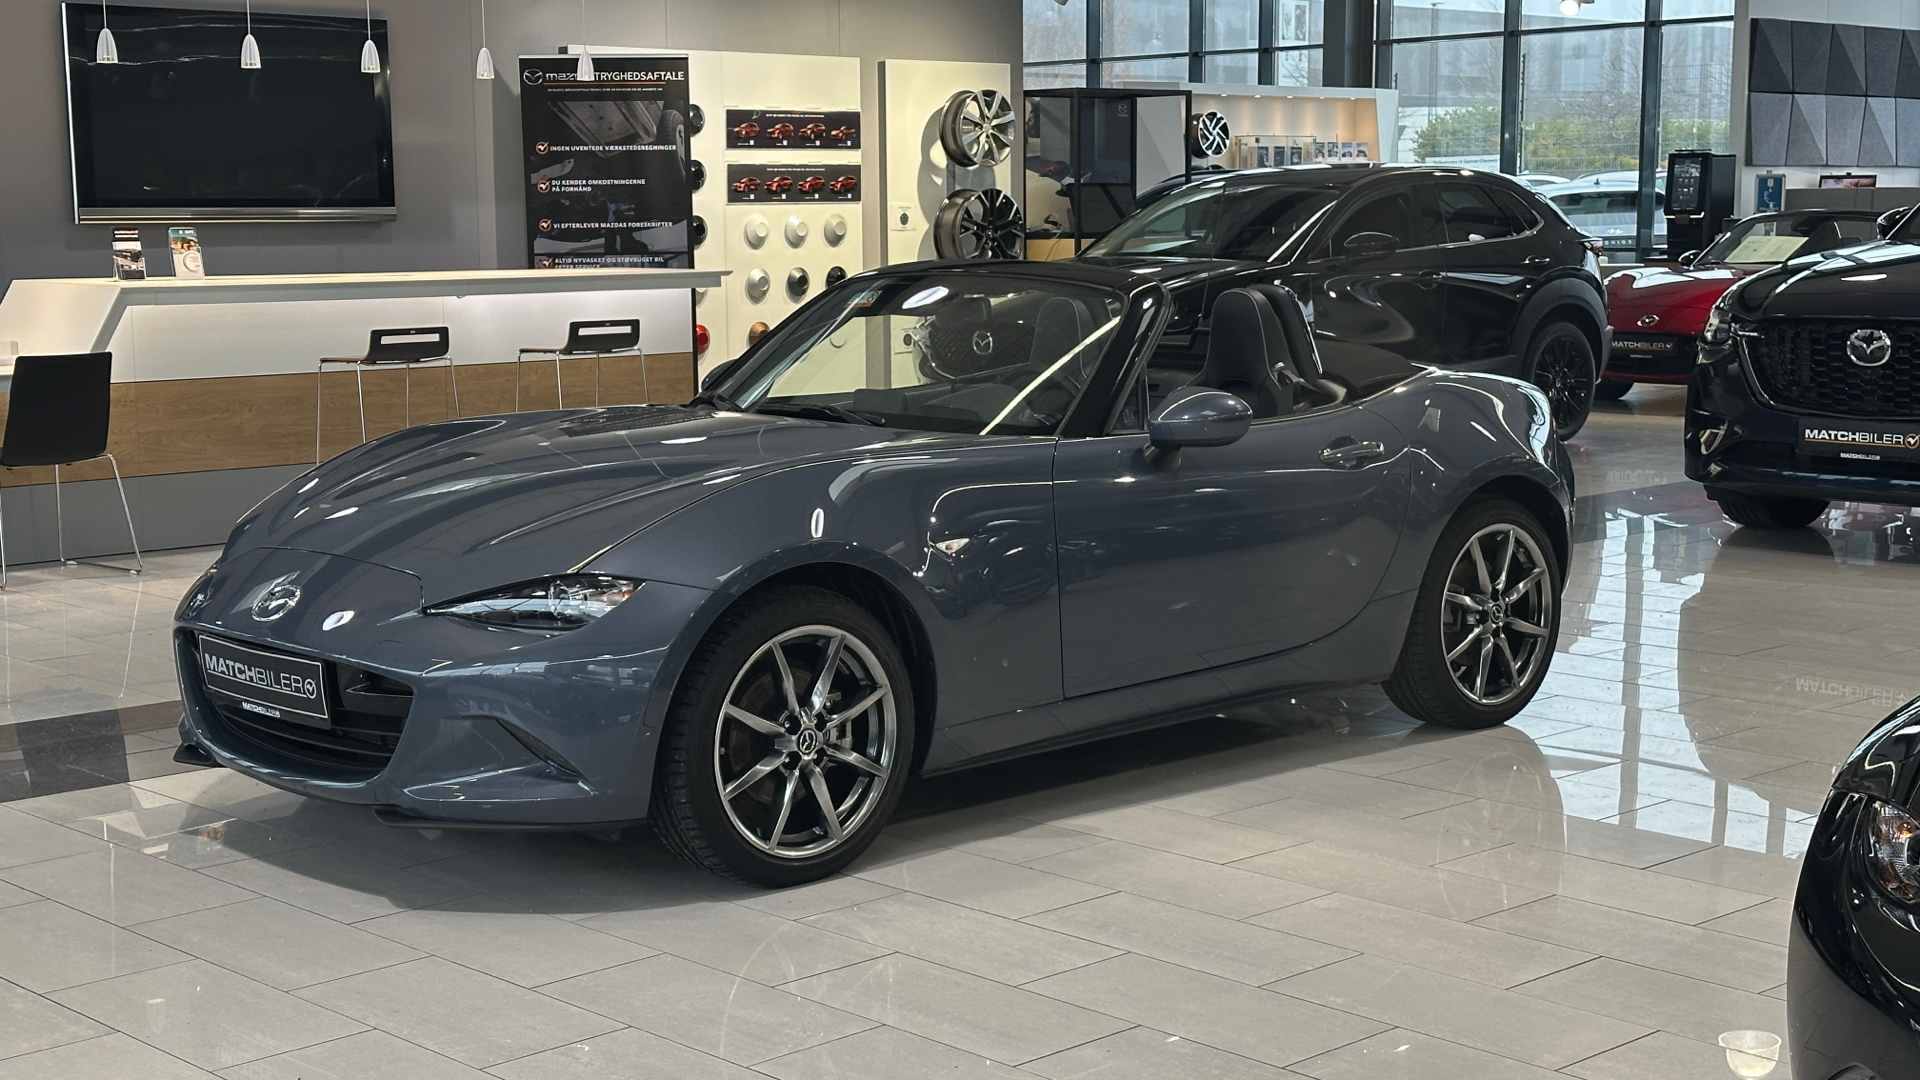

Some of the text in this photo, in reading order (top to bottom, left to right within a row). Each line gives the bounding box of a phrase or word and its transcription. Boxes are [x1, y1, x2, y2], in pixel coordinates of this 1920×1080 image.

[594, 71, 684, 81] TRYGHEDSAFTALE
[1611, 341, 1664, 349] MATCHBILER
[1805, 429, 1904, 445] MATCHBILER
[205, 653, 304, 693] MATCHBILER
